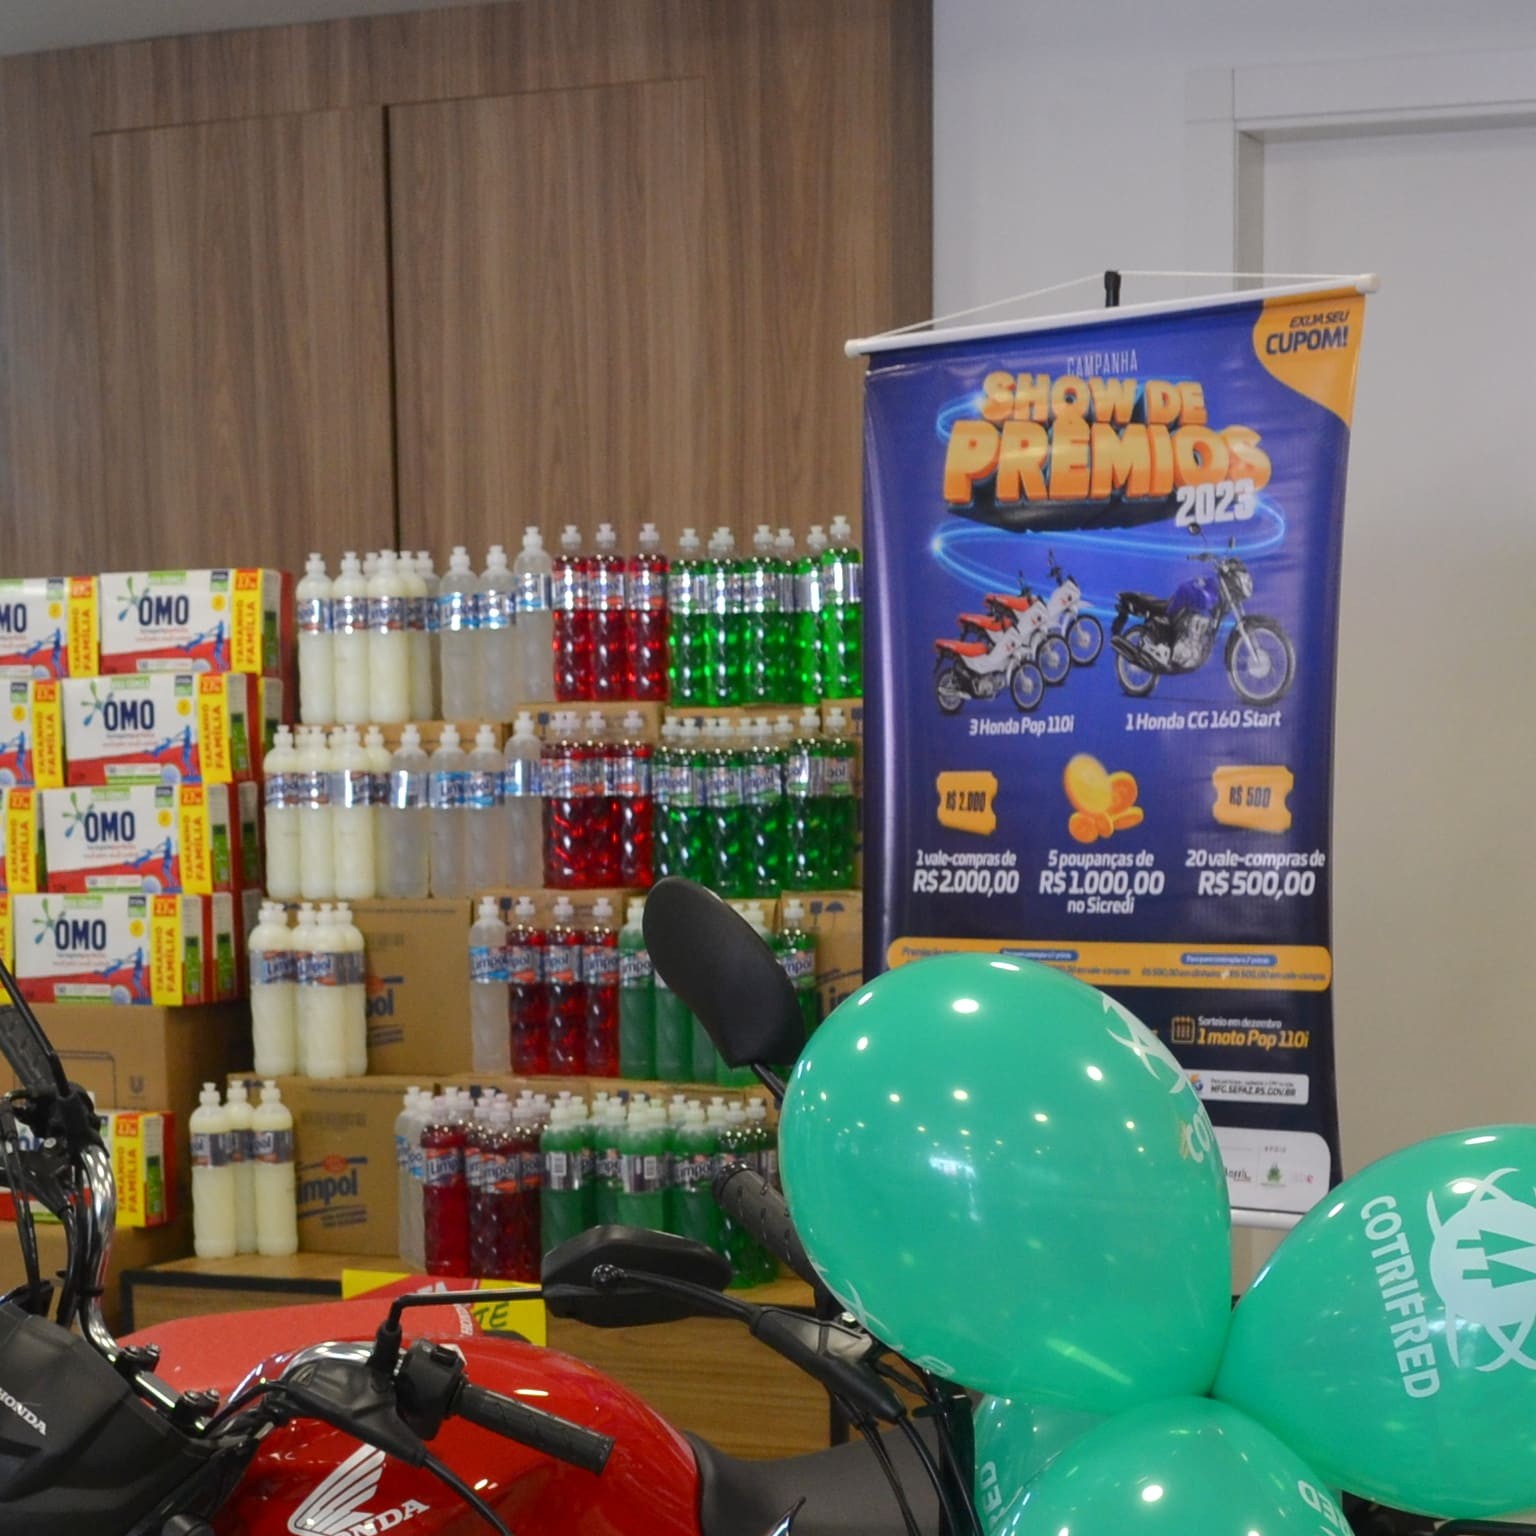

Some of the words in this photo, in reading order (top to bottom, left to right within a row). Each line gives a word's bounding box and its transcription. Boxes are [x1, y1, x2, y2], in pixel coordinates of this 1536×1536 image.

[1266, 325, 1349, 355] CUPOM!
[1067, 349, 1139, 378] CAMPANHA
[981, 371, 1139, 424] SHOW
[1146, 379, 1208, 427] DE
[1175, 478, 1257, 528] 2023
[969, 718, 978, 736] 3
[979, 717, 1019, 736] Honda
[1021, 717, 1045, 737] Pop
[1047, 715, 1075, 734] 110i
[1137, 712, 1185, 730] Honda
[1187, 711, 1210, 729] CG
[1210, 710, 1241, 729] 160
[1241, 709, 1281, 728] Start
[1229, 785, 1243, 807] R$
[1246, 786, 1271, 808] 500
[924, 849, 1002, 870] vale-compras
[1002, 850, 1017, 867] de
[1048, 850, 1058, 867] 5
[1058, 852, 1134, 871] poupanças
[1135, 850, 1154, 867] de
[1185, 849, 1207, 867] 20
[1208, 849, 1308, 870] vale-compras
[1309, 849, 1326, 867] de
[1067, 900, 1086, 913] no
[1087, 896, 1135, 915] Sicredi
[1207, 1031, 1245, 1047] moto
[1247, 1029, 1276, 1050] Pop
[1357, 1193, 1443, 1400] COTRIFRED
